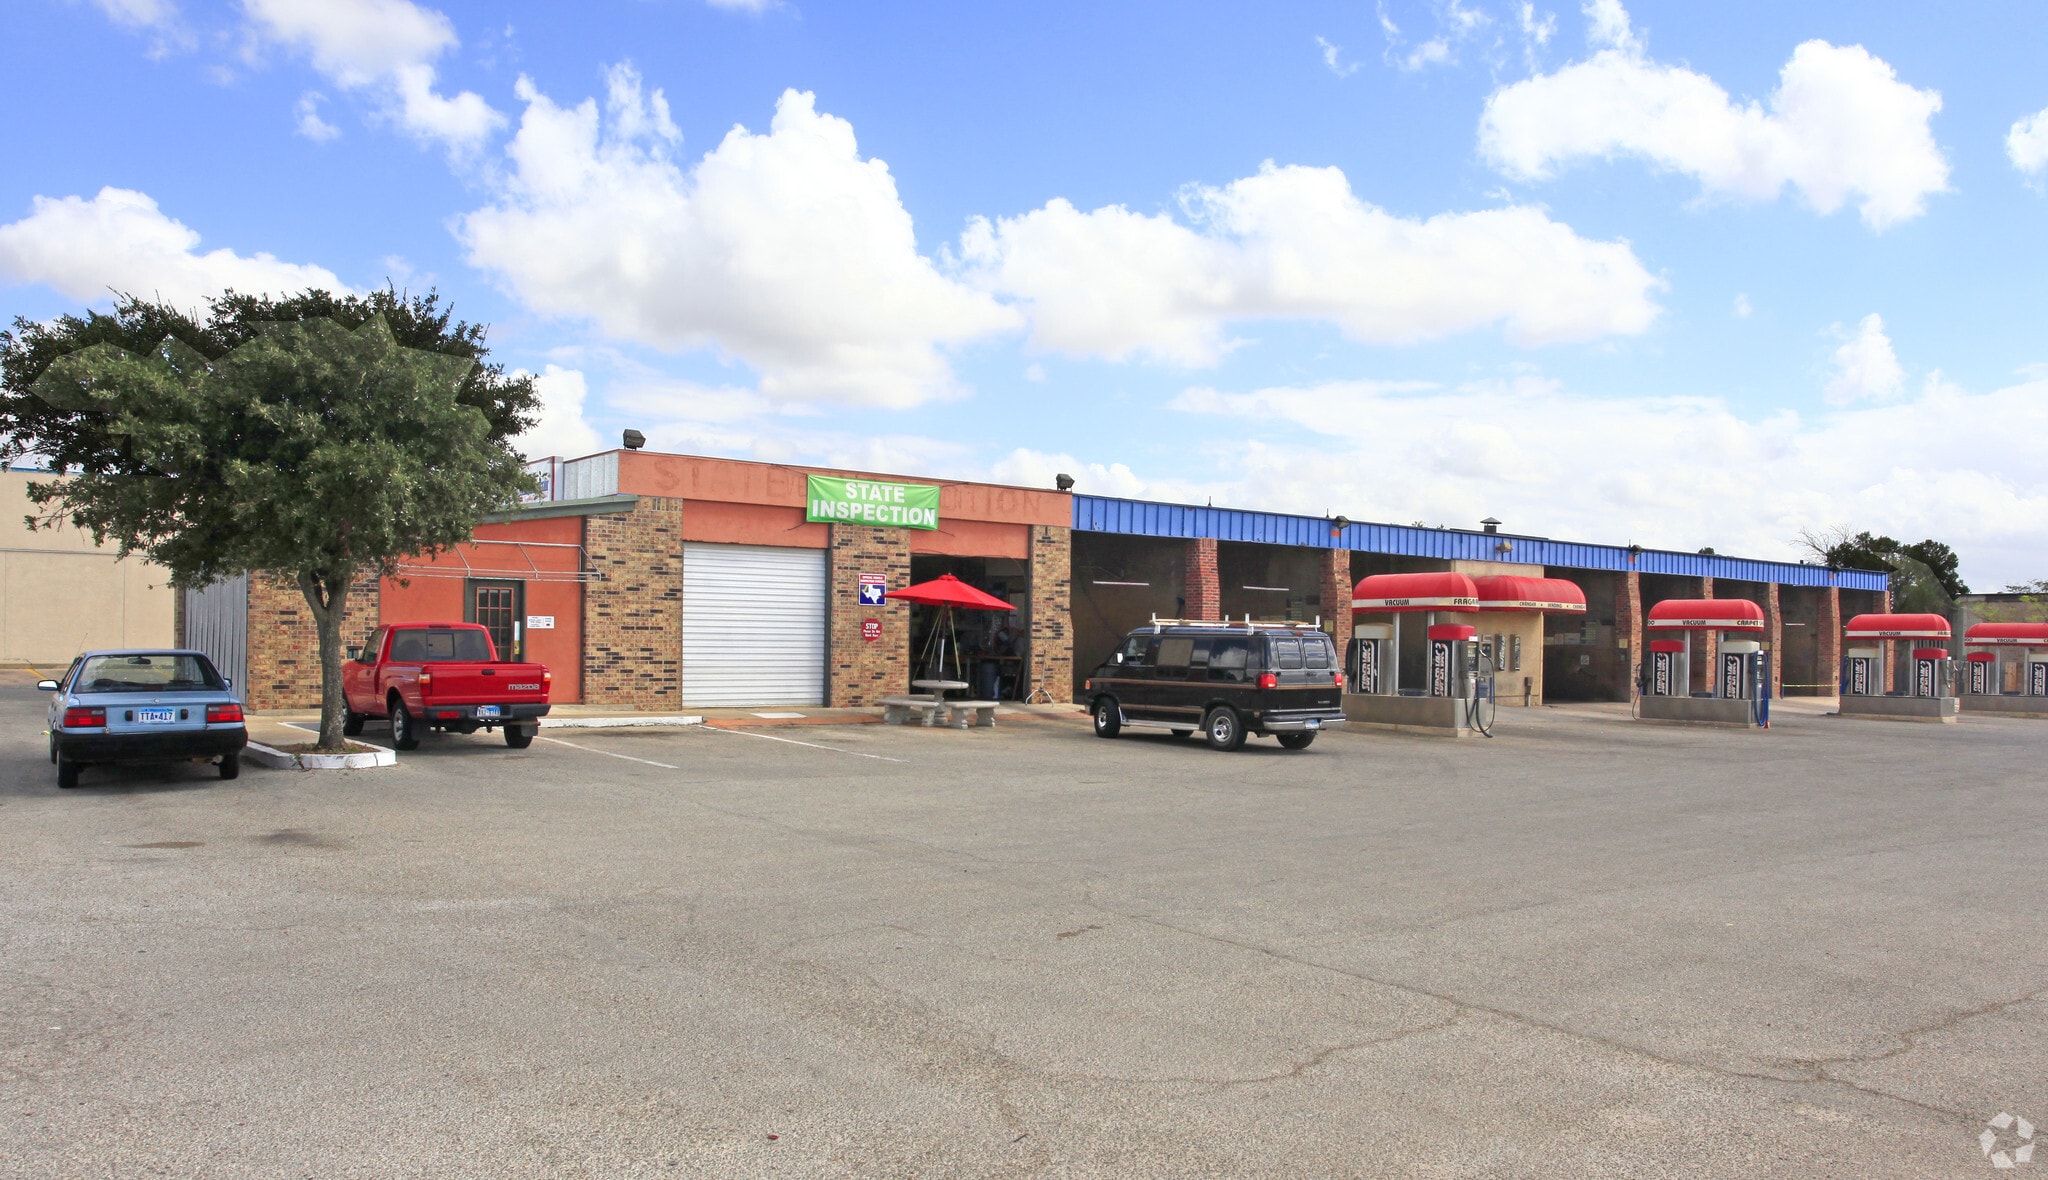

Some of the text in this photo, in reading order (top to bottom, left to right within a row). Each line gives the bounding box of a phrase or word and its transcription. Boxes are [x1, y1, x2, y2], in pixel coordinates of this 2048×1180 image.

[846, 483, 905, 503] STATE
[812, 499, 936, 526] INSPECTION
[1362, 646, 1370, 691] SUPER VAC
[1435, 649, 1444, 696] SUPER VAC
[1657, 657, 1665, 693] SUPER VAC
[1727, 660, 1736, 698] SUPER VAC
[1920, 665, 1928, 696] SUPER VAC
